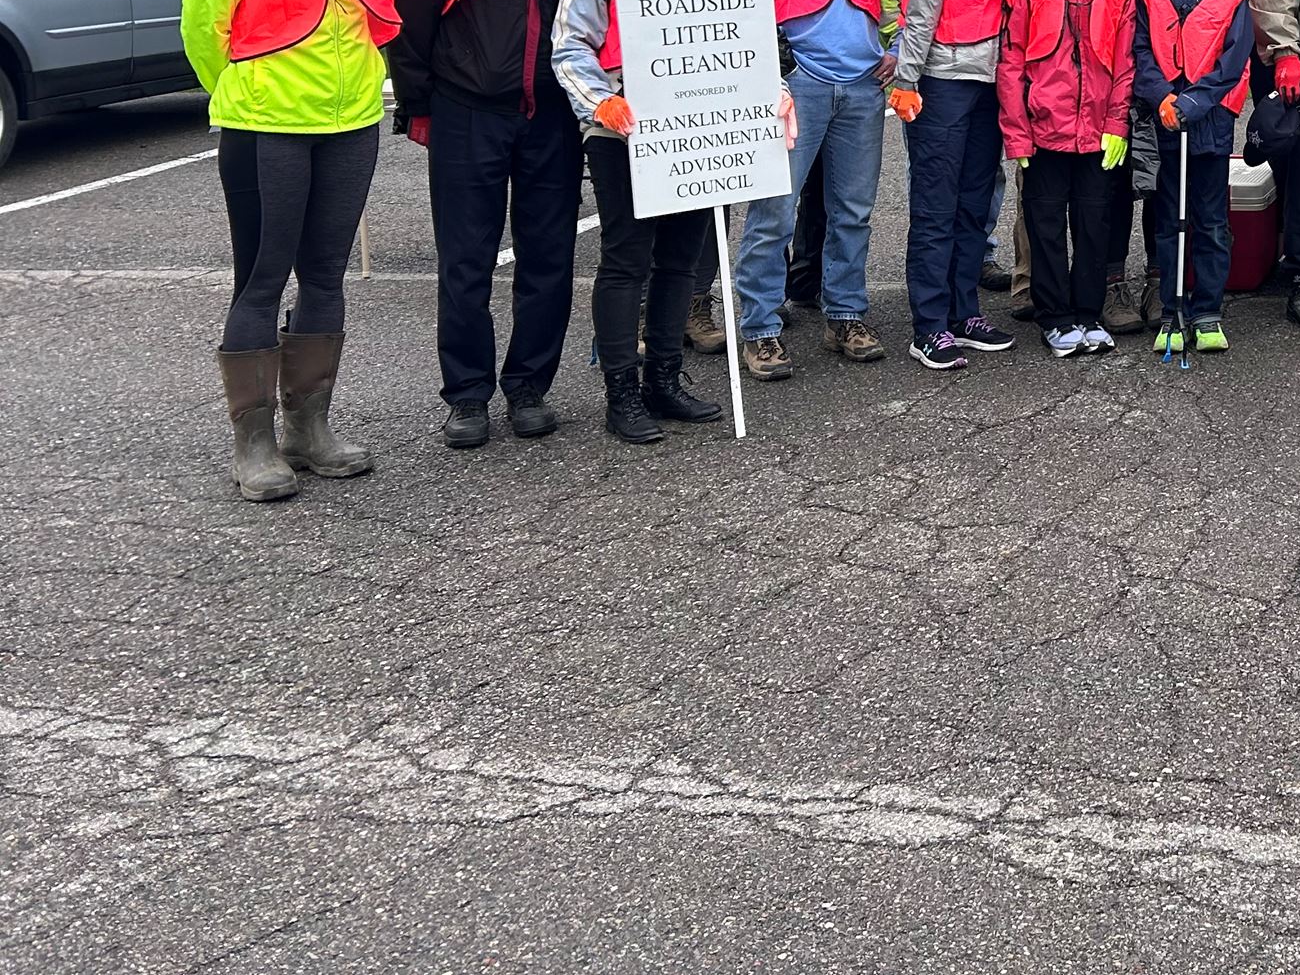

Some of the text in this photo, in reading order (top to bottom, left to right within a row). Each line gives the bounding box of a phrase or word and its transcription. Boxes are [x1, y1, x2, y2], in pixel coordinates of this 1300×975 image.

[660, 22, 741, 47] LITTER
[650, 50, 756, 78] CLEANUP
[674, 84, 739, 100] SPONSORED BY
[638, 103, 775, 135] FRANKLIN PARK
[633, 125, 784, 159] ENVIRONMENTAL
[668, 150, 757, 177] ADVISORY
[676, 174, 753, 198] COUNCIL
